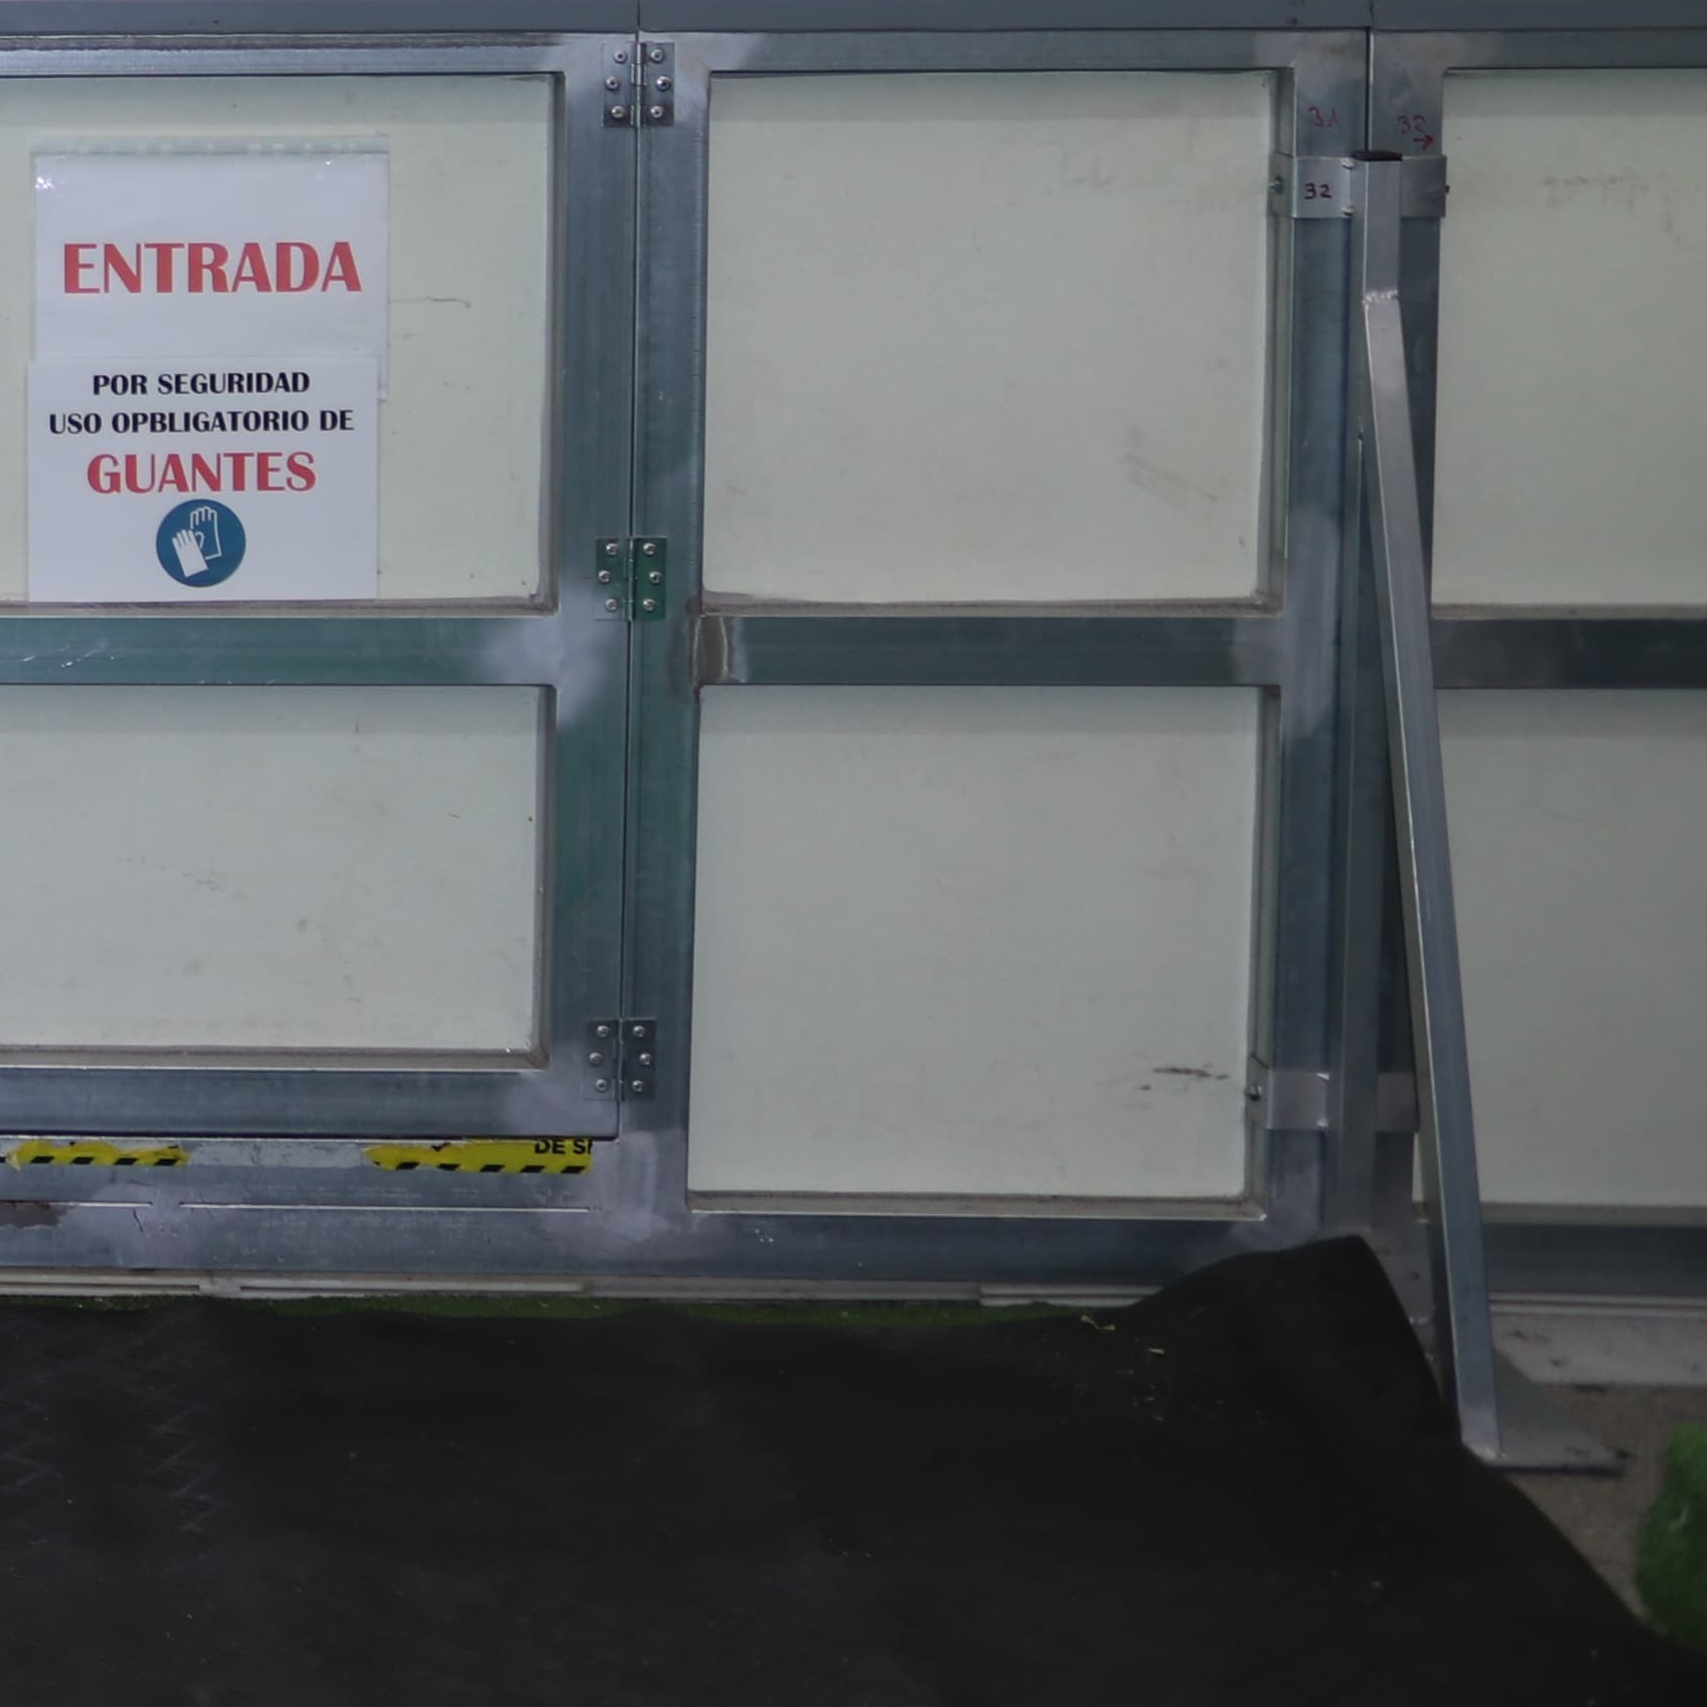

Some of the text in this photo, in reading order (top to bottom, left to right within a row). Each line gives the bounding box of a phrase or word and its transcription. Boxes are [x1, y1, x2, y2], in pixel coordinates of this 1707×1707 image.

[1303, 182, 1332, 200] 32
[63, 241, 363, 294] ENTRADA
[93, 371, 310, 396] POR SEGURIDAD
[49, 409, 354, 434] USO OPBLIGATORIO DE
[87, 451, 317, 494] GUANTES
[534, 1138, 566, 1154] DE
